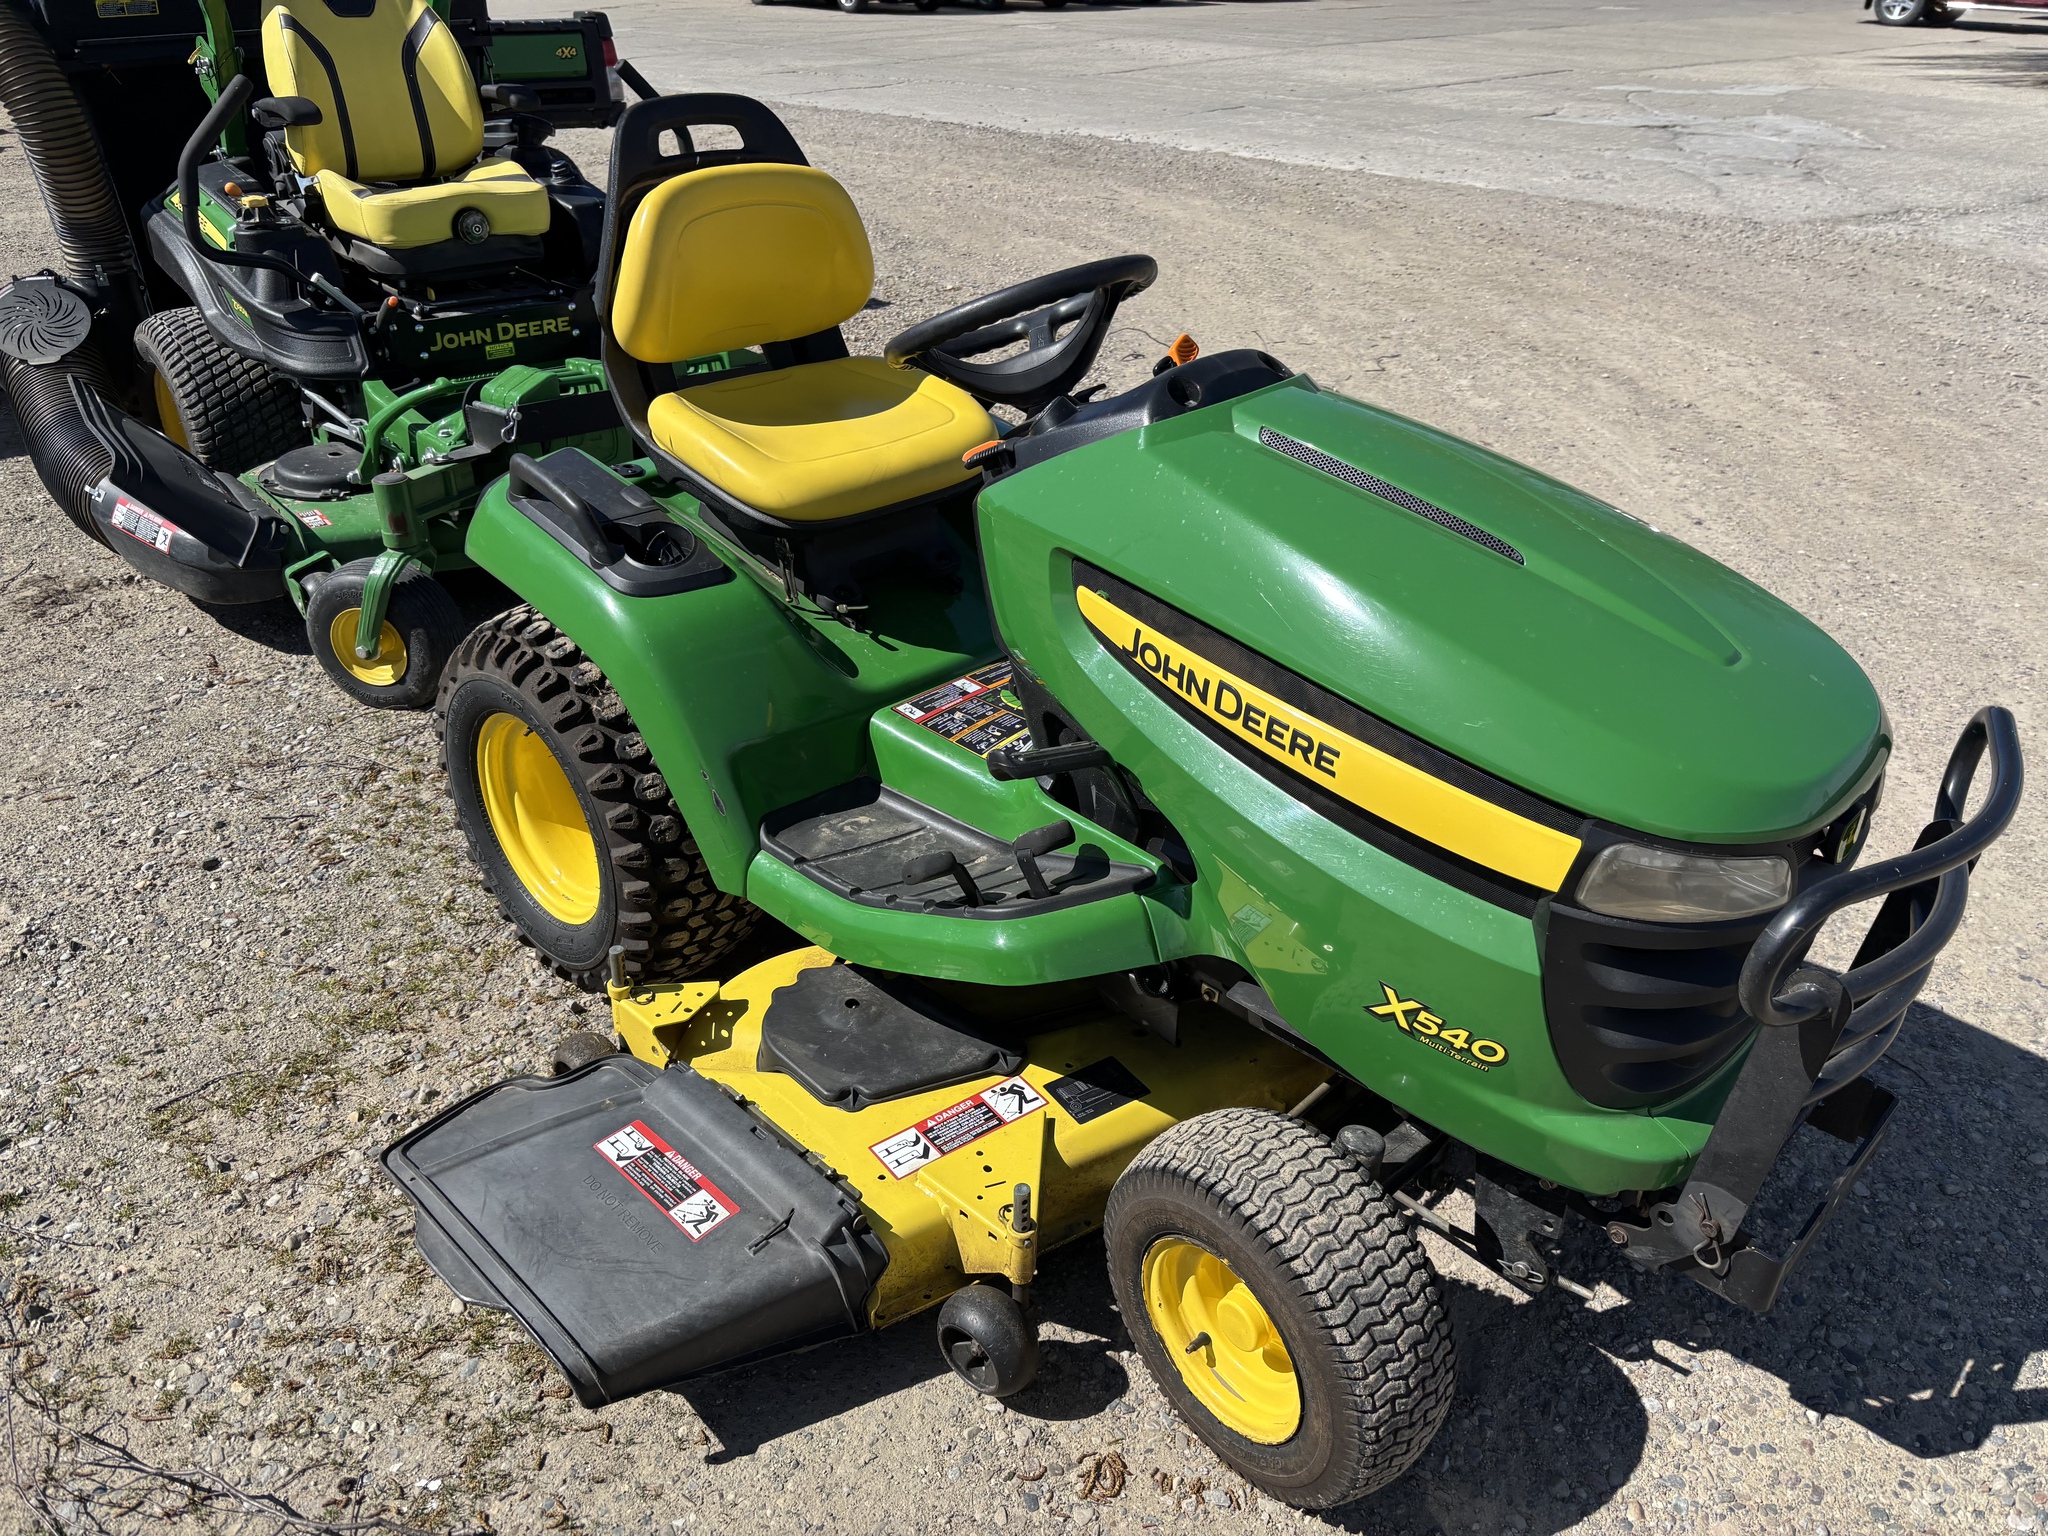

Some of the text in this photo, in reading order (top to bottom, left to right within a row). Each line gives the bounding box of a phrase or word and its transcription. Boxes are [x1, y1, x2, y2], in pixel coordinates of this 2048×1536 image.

[555, 46, 577, 58] 4X4
[430, 316, 571, 351] JOHN DEERE
[1121, 627, 1341, 779] JOHN DEERE
[1364, 981, 1509, 1066] X540
[1419, 1036, 1490, 1072] Multi-Terrain
[934, 1099, 975, 1123] DANGER
[673, 1154, 703, 1181] DANGER
[583, 1174, 601, 1191] DO
[597, 1191, 624, 1211] NOT
[618, 1210, 664, 1254] REMOVE
